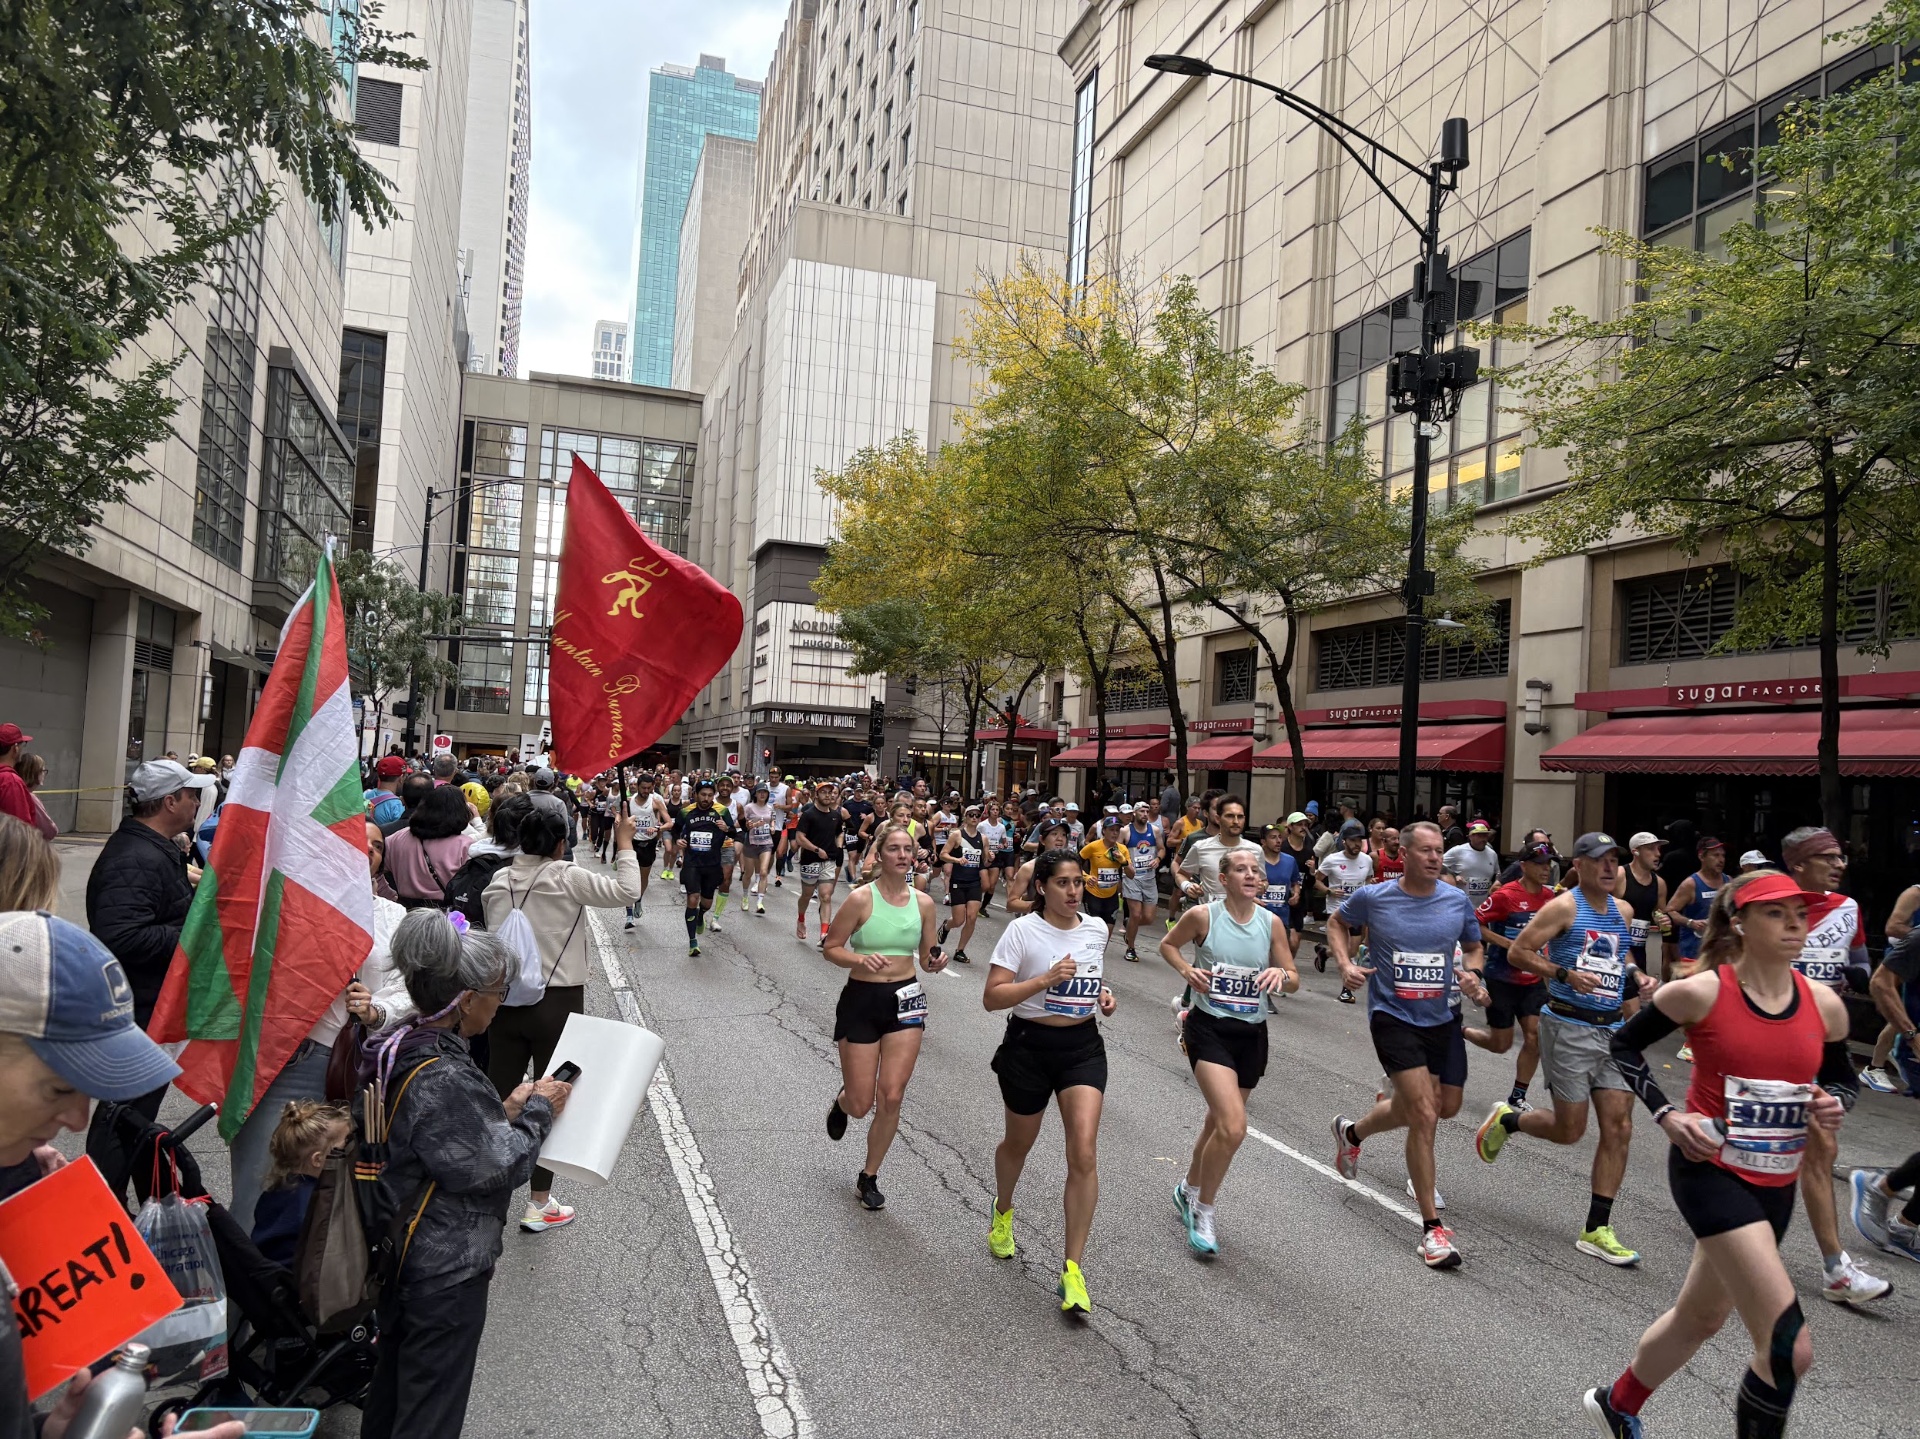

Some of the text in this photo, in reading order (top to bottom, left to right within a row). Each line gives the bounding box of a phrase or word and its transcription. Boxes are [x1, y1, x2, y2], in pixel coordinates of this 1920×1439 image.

[551, 610, 603, 677] untain
[803, 639, 854, 650] HUGO BOS
[1677, 684, 1821, 703] sugar FACTOR
[771, 710, 783, 723] THE
[785, 711, 805, 724] SHOPS
[810, 713, 832, 727] NORTH
[833, 715, 857, 728] BRIDGE
[1329, 709, 1363, 720] sugar
[1194, 722, 1217, 730] sugar
[689, 815, 717, 825] BRASIL
[1394, 966, 1403, 979] D
[1407, 967, 1444, 981] 18432
[1065, 978, 1101, 996] 7122
[1211, 977, 1260, 996] E 3919
[1728, 1101, 1744, 1123] E
